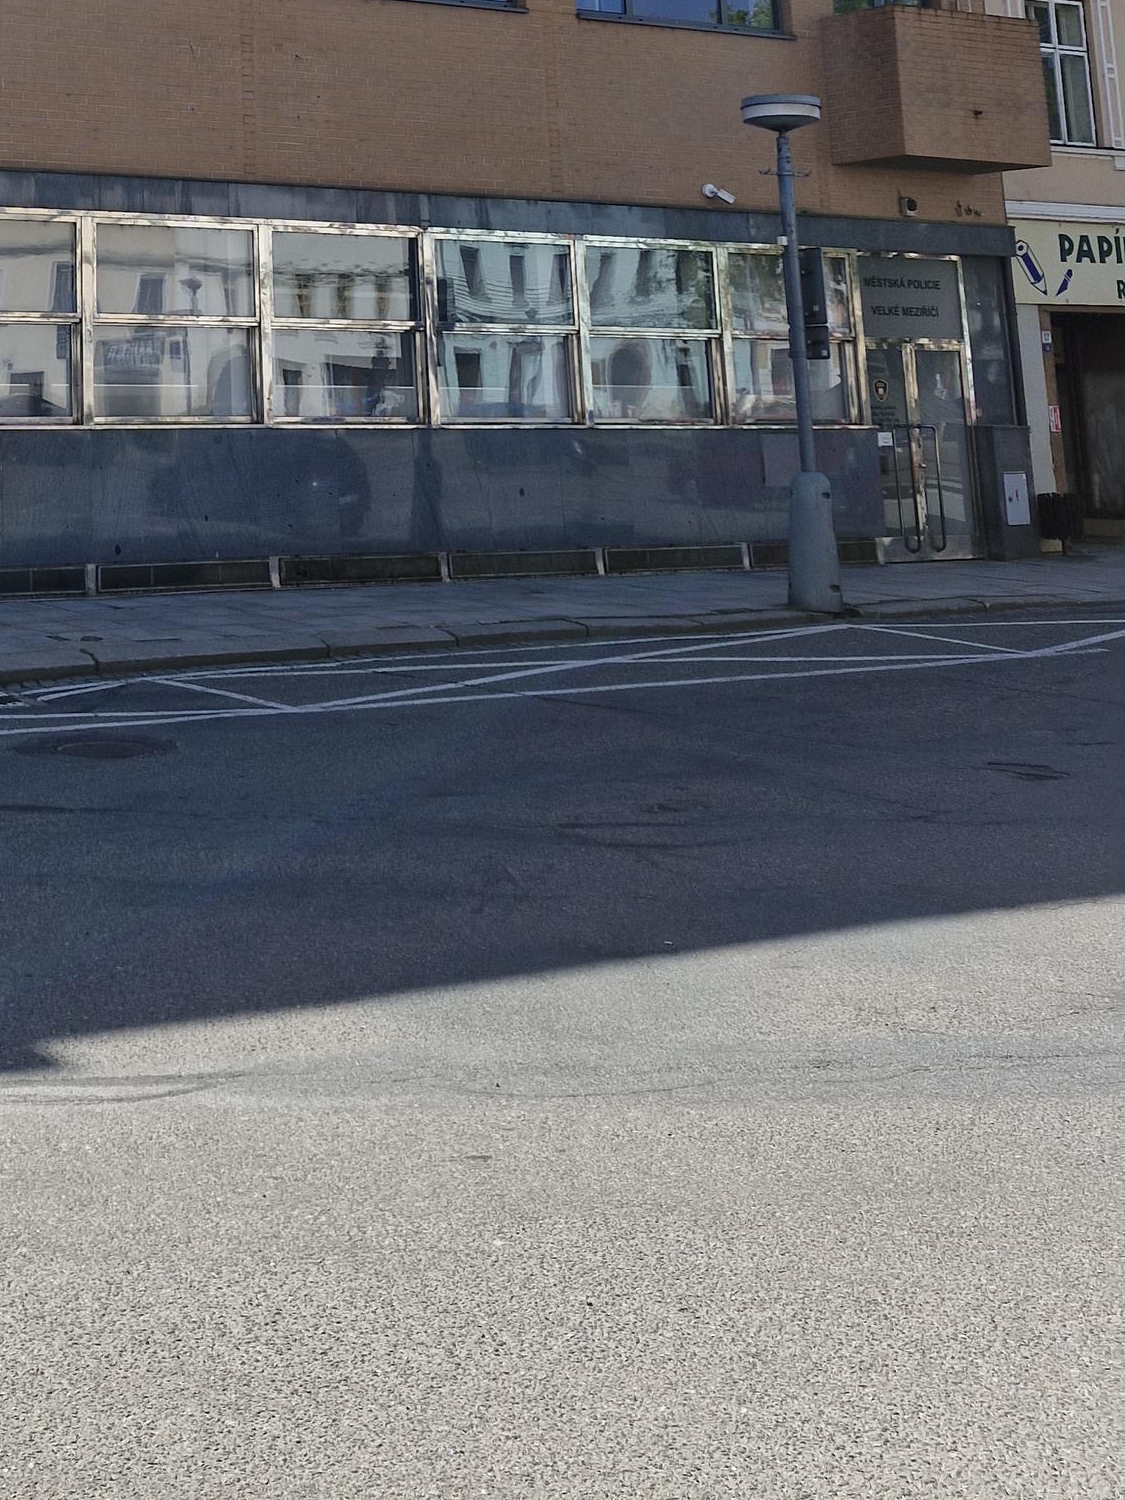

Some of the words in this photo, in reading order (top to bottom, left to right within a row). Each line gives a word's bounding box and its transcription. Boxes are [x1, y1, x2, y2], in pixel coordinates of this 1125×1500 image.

[1058, 228, 1125, 264] PAPÍ
[864, 275, 906, 288] MĚSTSKÁ
[907, 279, 941, 290] POLICIE
[871, 303, 899, 316] VELKÉ
[902, 305, 939, 318] MEZIŘÍČÍ
